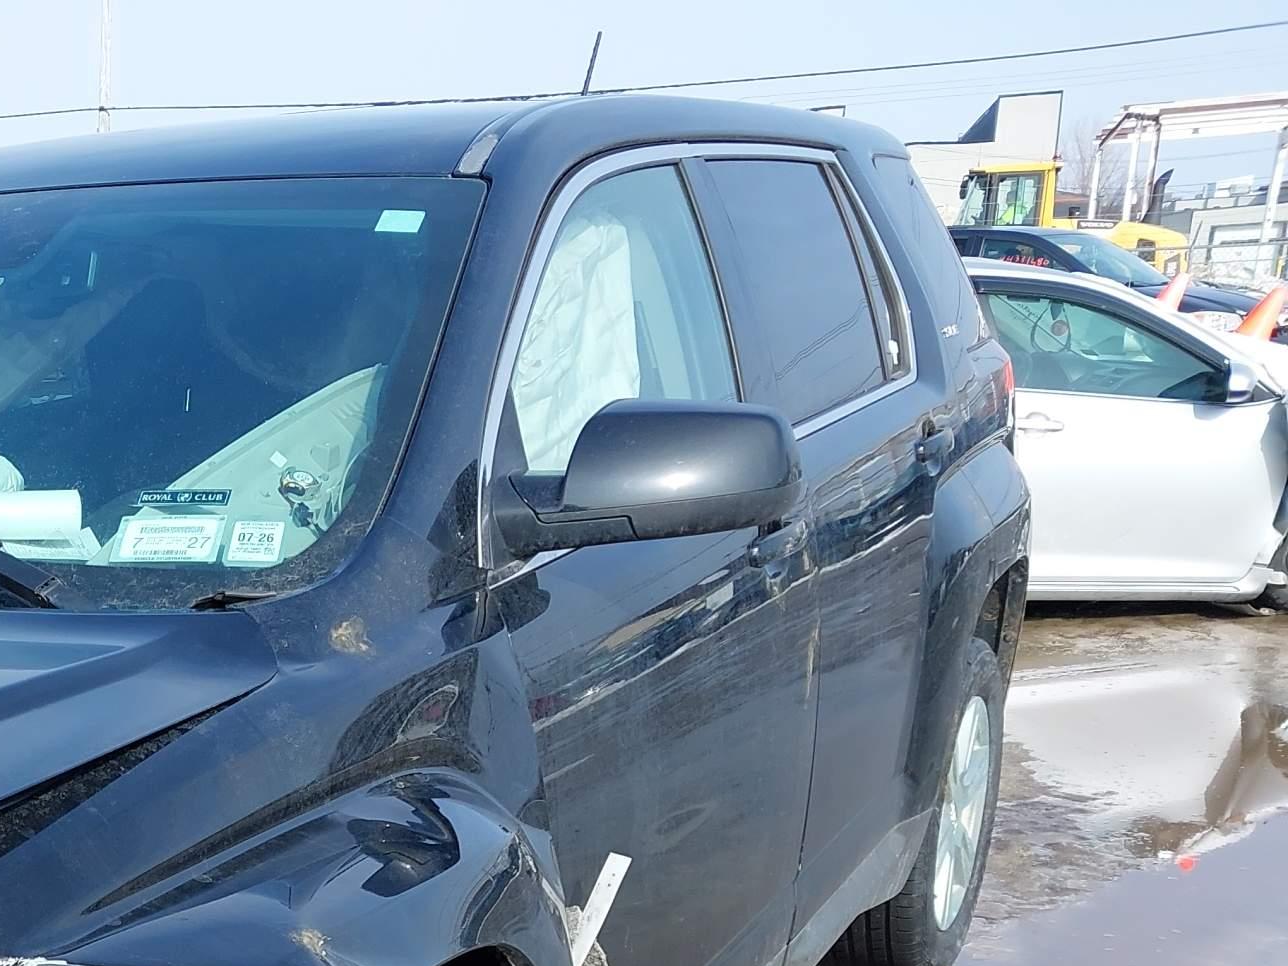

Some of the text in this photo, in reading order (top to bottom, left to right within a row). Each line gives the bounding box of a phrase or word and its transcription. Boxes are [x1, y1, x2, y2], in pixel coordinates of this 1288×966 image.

[141, 493, 223, 502] ROYAL CLUB
[132, 537, 145, 549] 7
[187, 536, 212, 549] 27
